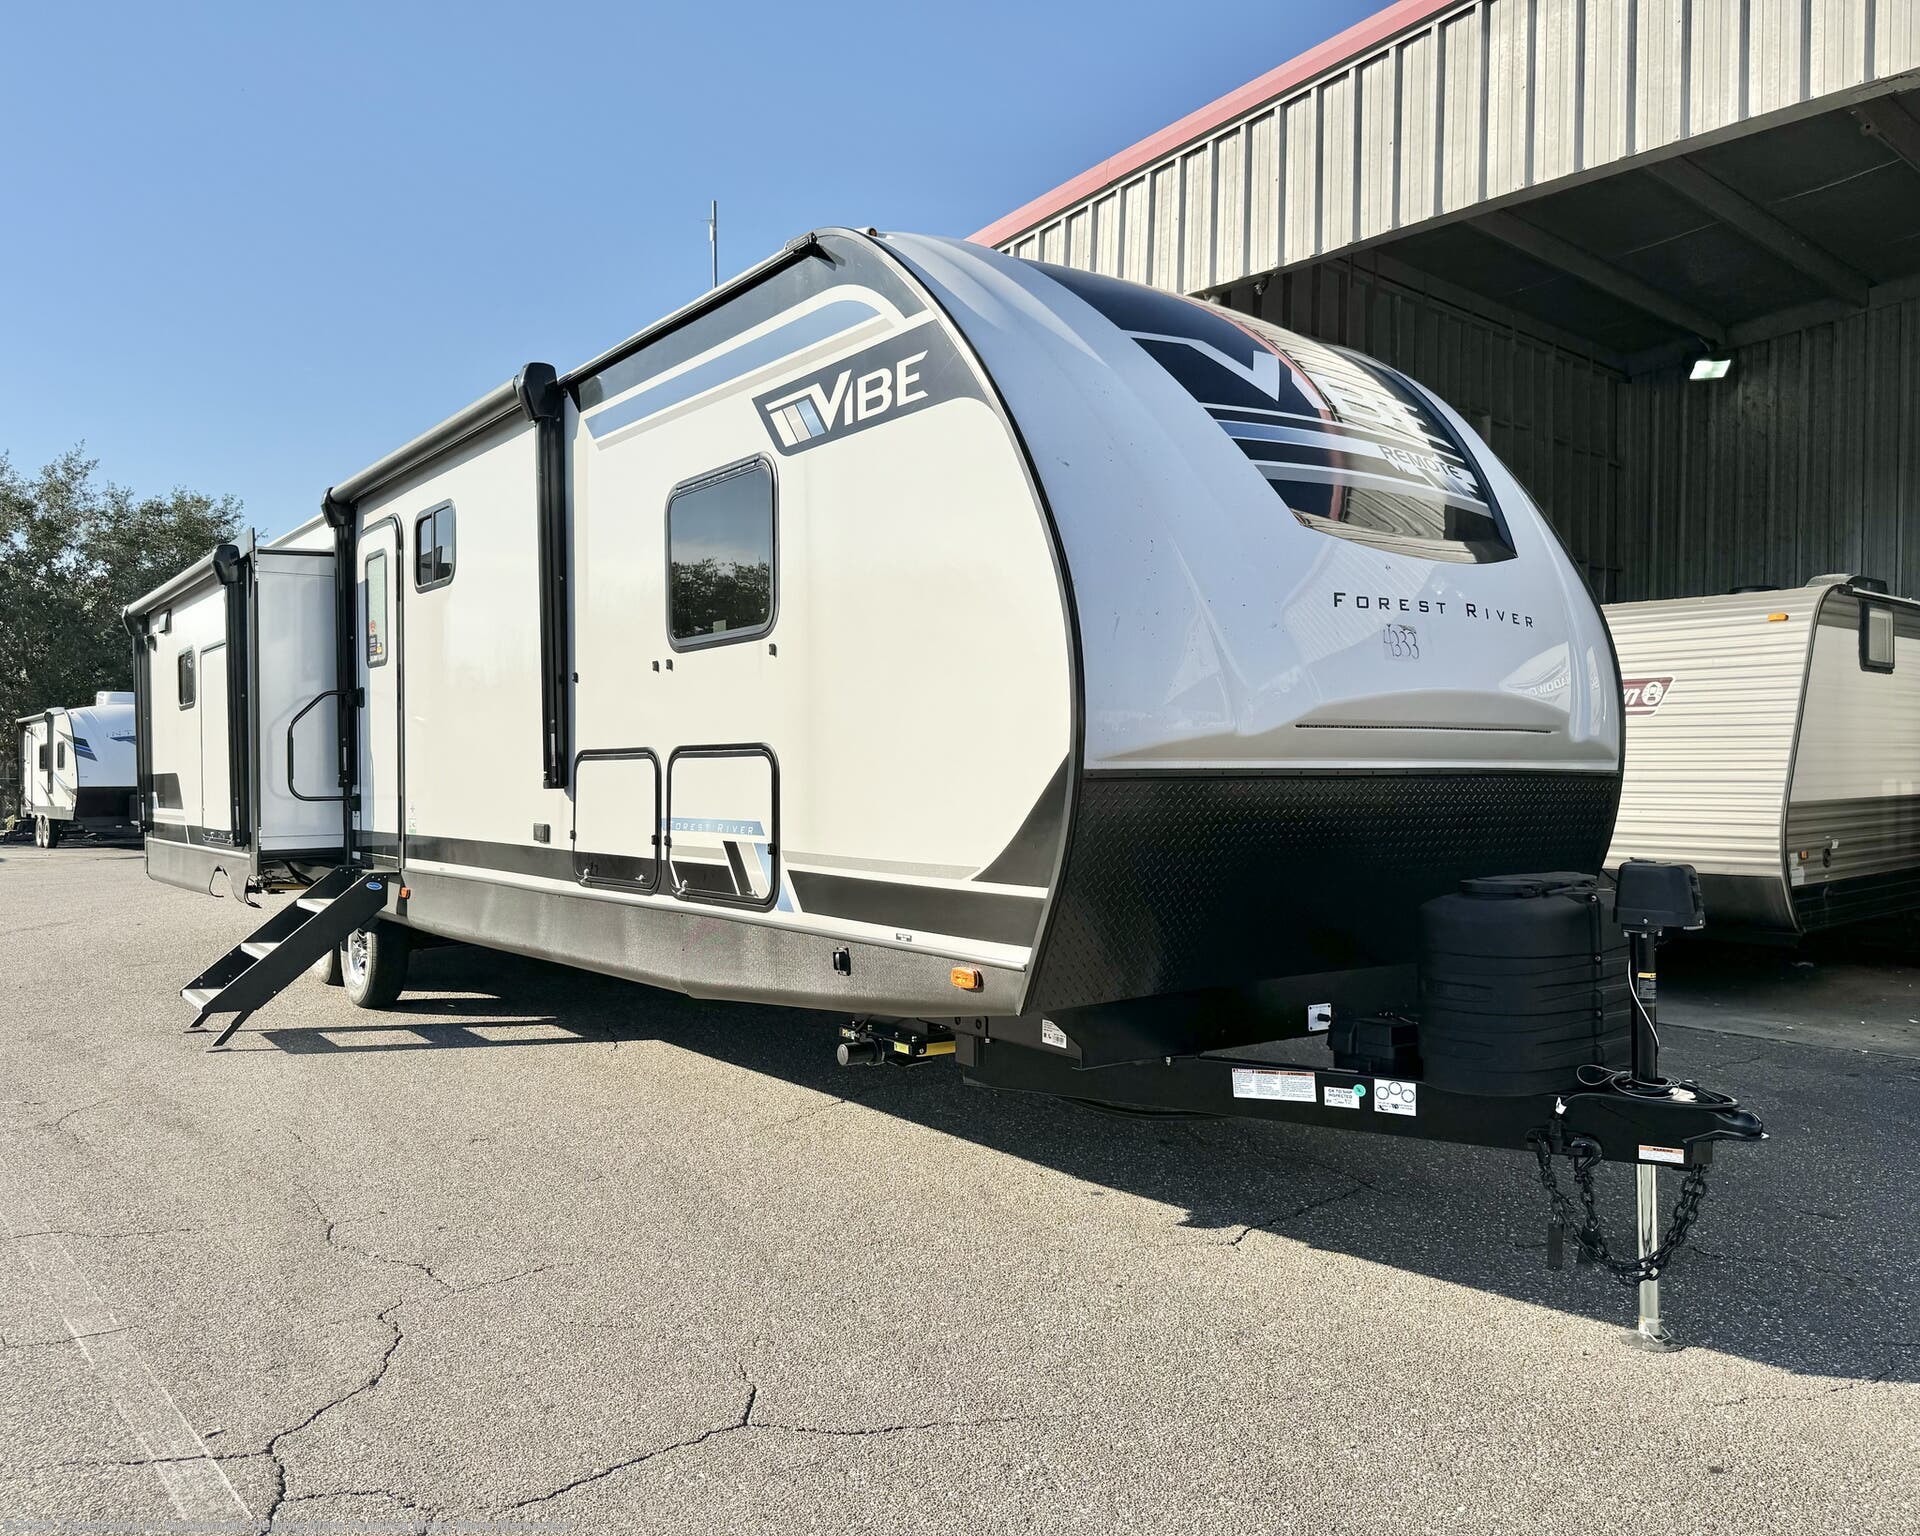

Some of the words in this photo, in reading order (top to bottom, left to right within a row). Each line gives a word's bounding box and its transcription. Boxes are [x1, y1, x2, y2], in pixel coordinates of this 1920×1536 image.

[790, 350, 929, 432] VIBE
[1379, 444, 1460, 481] REMOTE
[1333, 592, 1446, 614] FOREST
[1466, 603, 1534, 628] RIVER
[717, 823, 754, 836] RIVER
